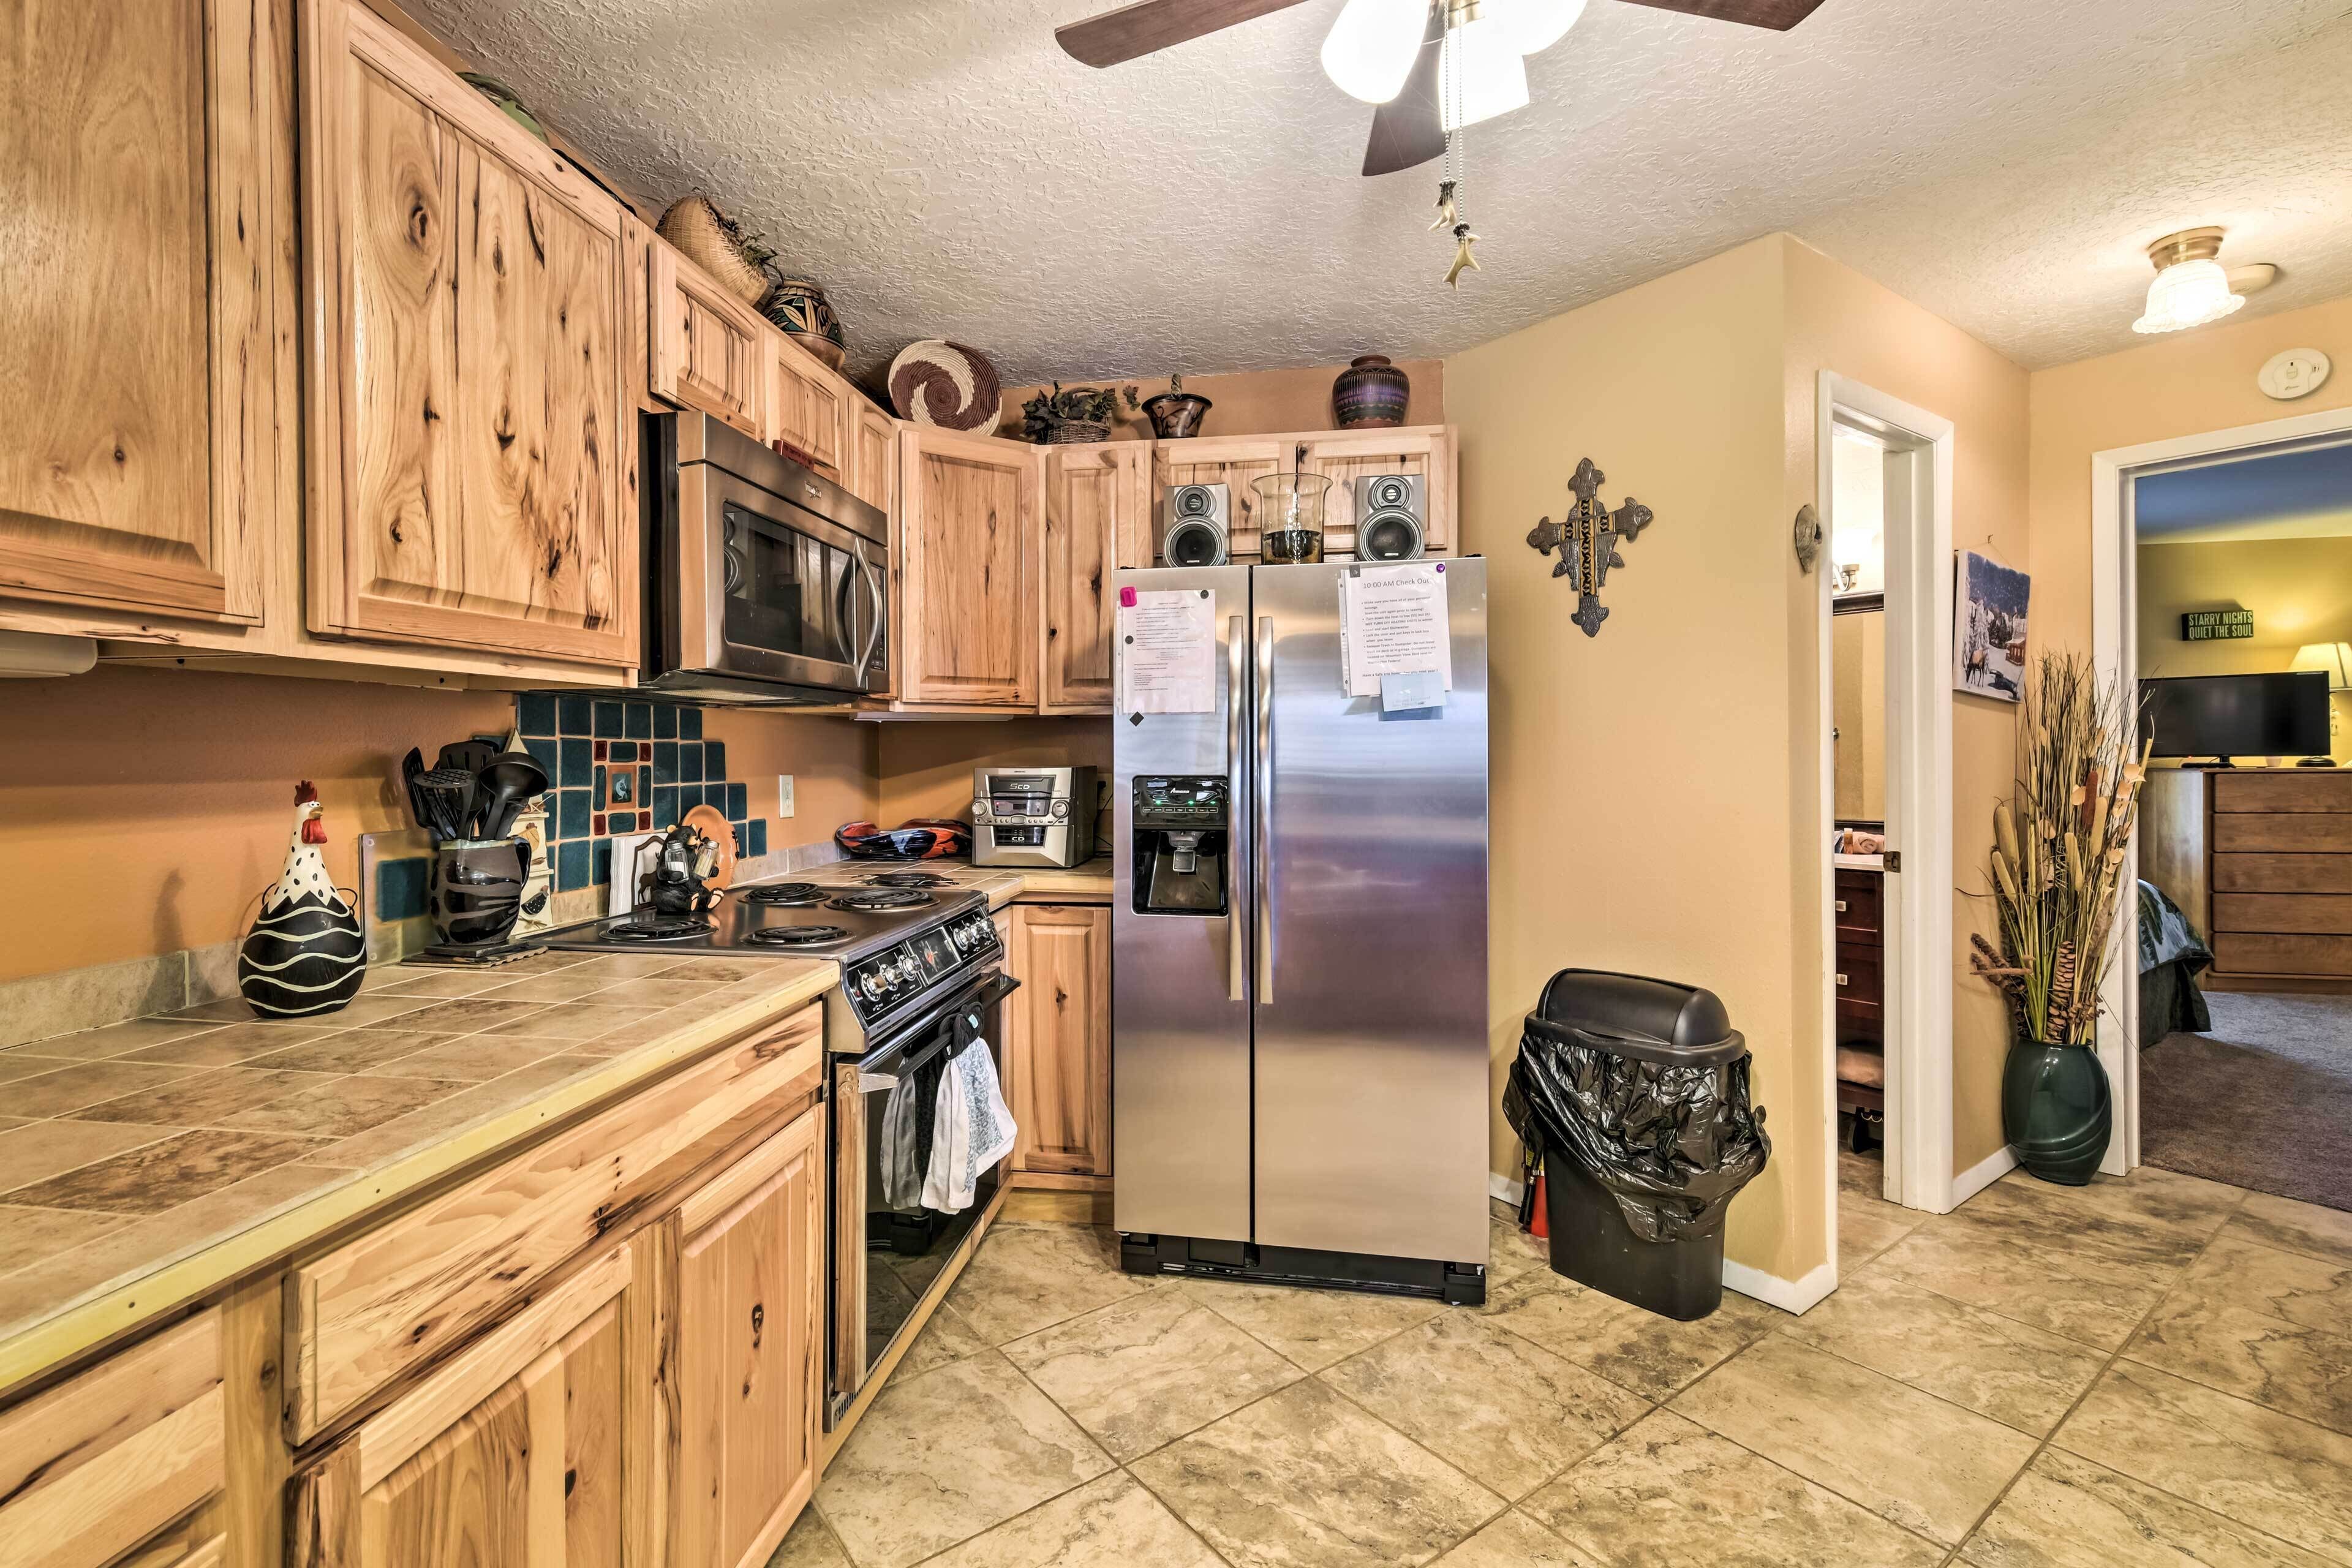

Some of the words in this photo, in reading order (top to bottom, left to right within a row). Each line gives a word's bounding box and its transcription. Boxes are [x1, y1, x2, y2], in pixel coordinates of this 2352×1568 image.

[2189, 613, 2221, 626] STARRY
[2223, 612, 2253, 624] NIGHTS
[2189, 626, 2212, 640] QUIET
[2215, 625, 2229, 637] THE
[2232, 624, 2253, 637] SOUL
